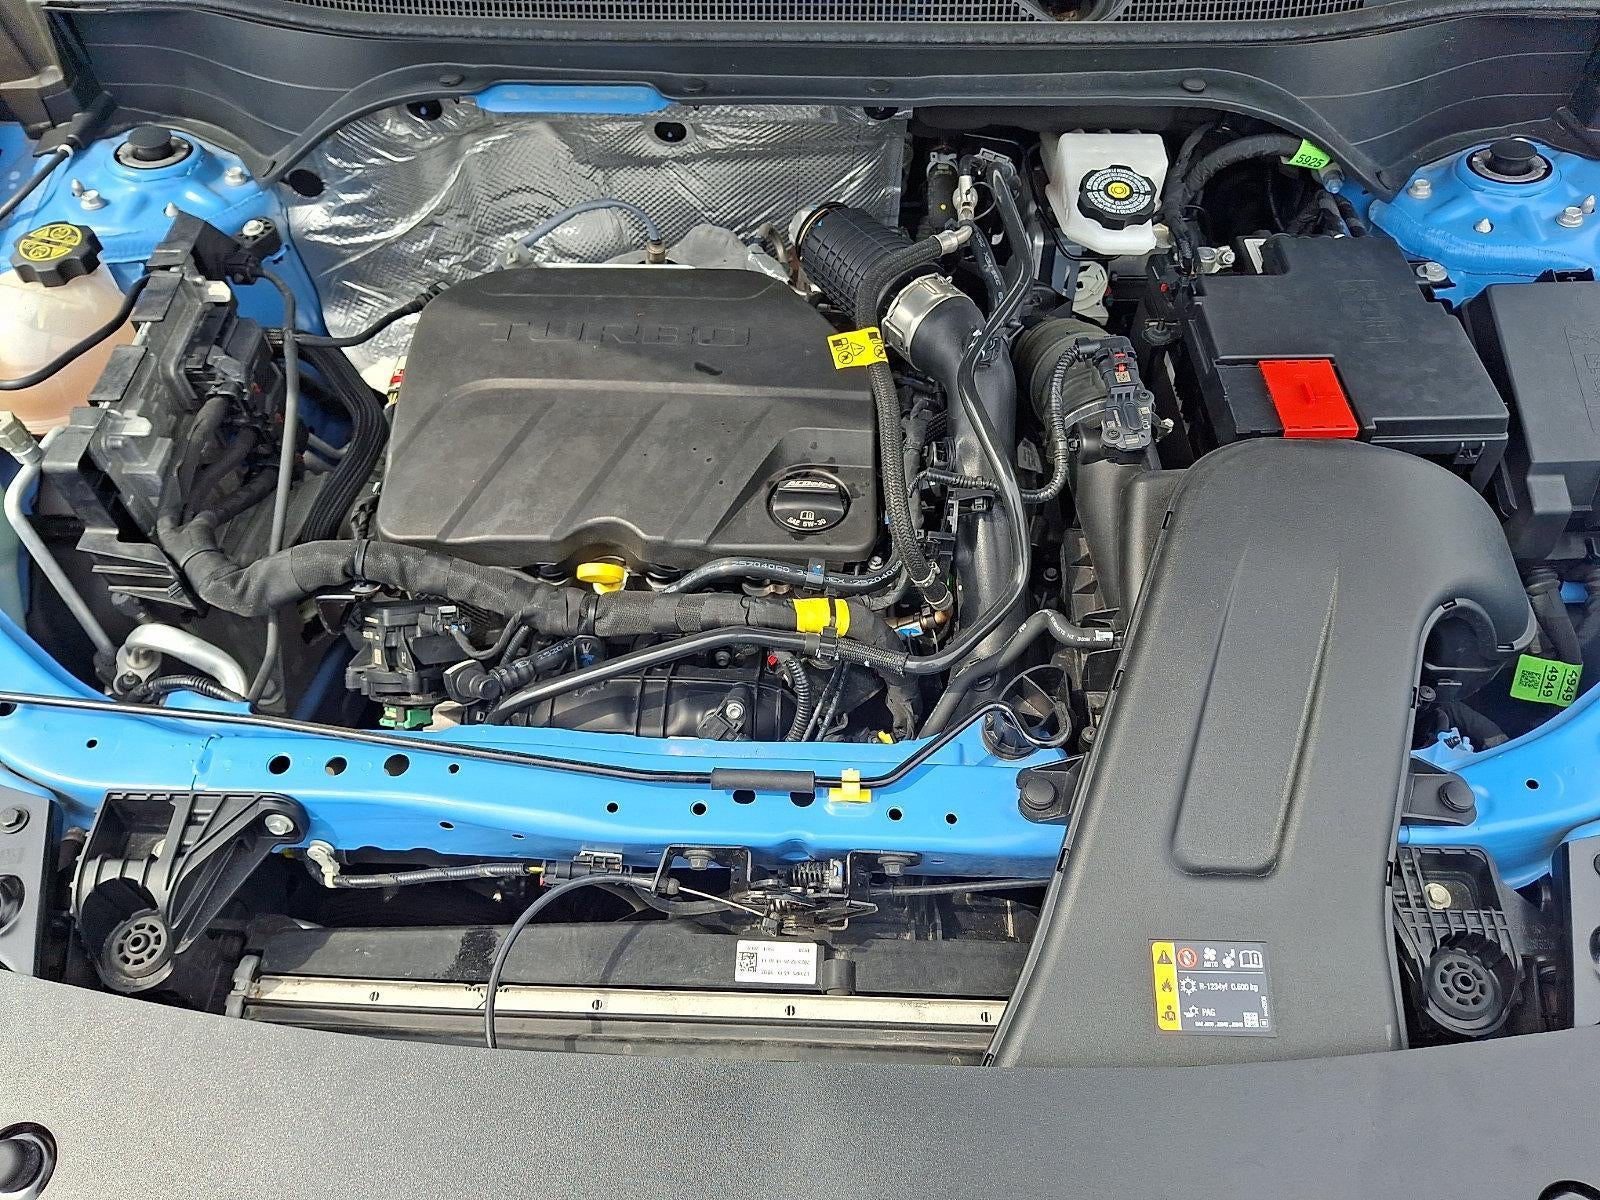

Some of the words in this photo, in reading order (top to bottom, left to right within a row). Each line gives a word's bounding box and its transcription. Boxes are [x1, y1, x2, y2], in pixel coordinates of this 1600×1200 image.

[1296, 154, 1324, 167] 5925
[478, 321, 752, 347] TURBO
[1542, 665, 1559, 697] 4949
[1562, 669, 1579, 702] 4949
[1201, 1008, 1216, 1017] PAG
